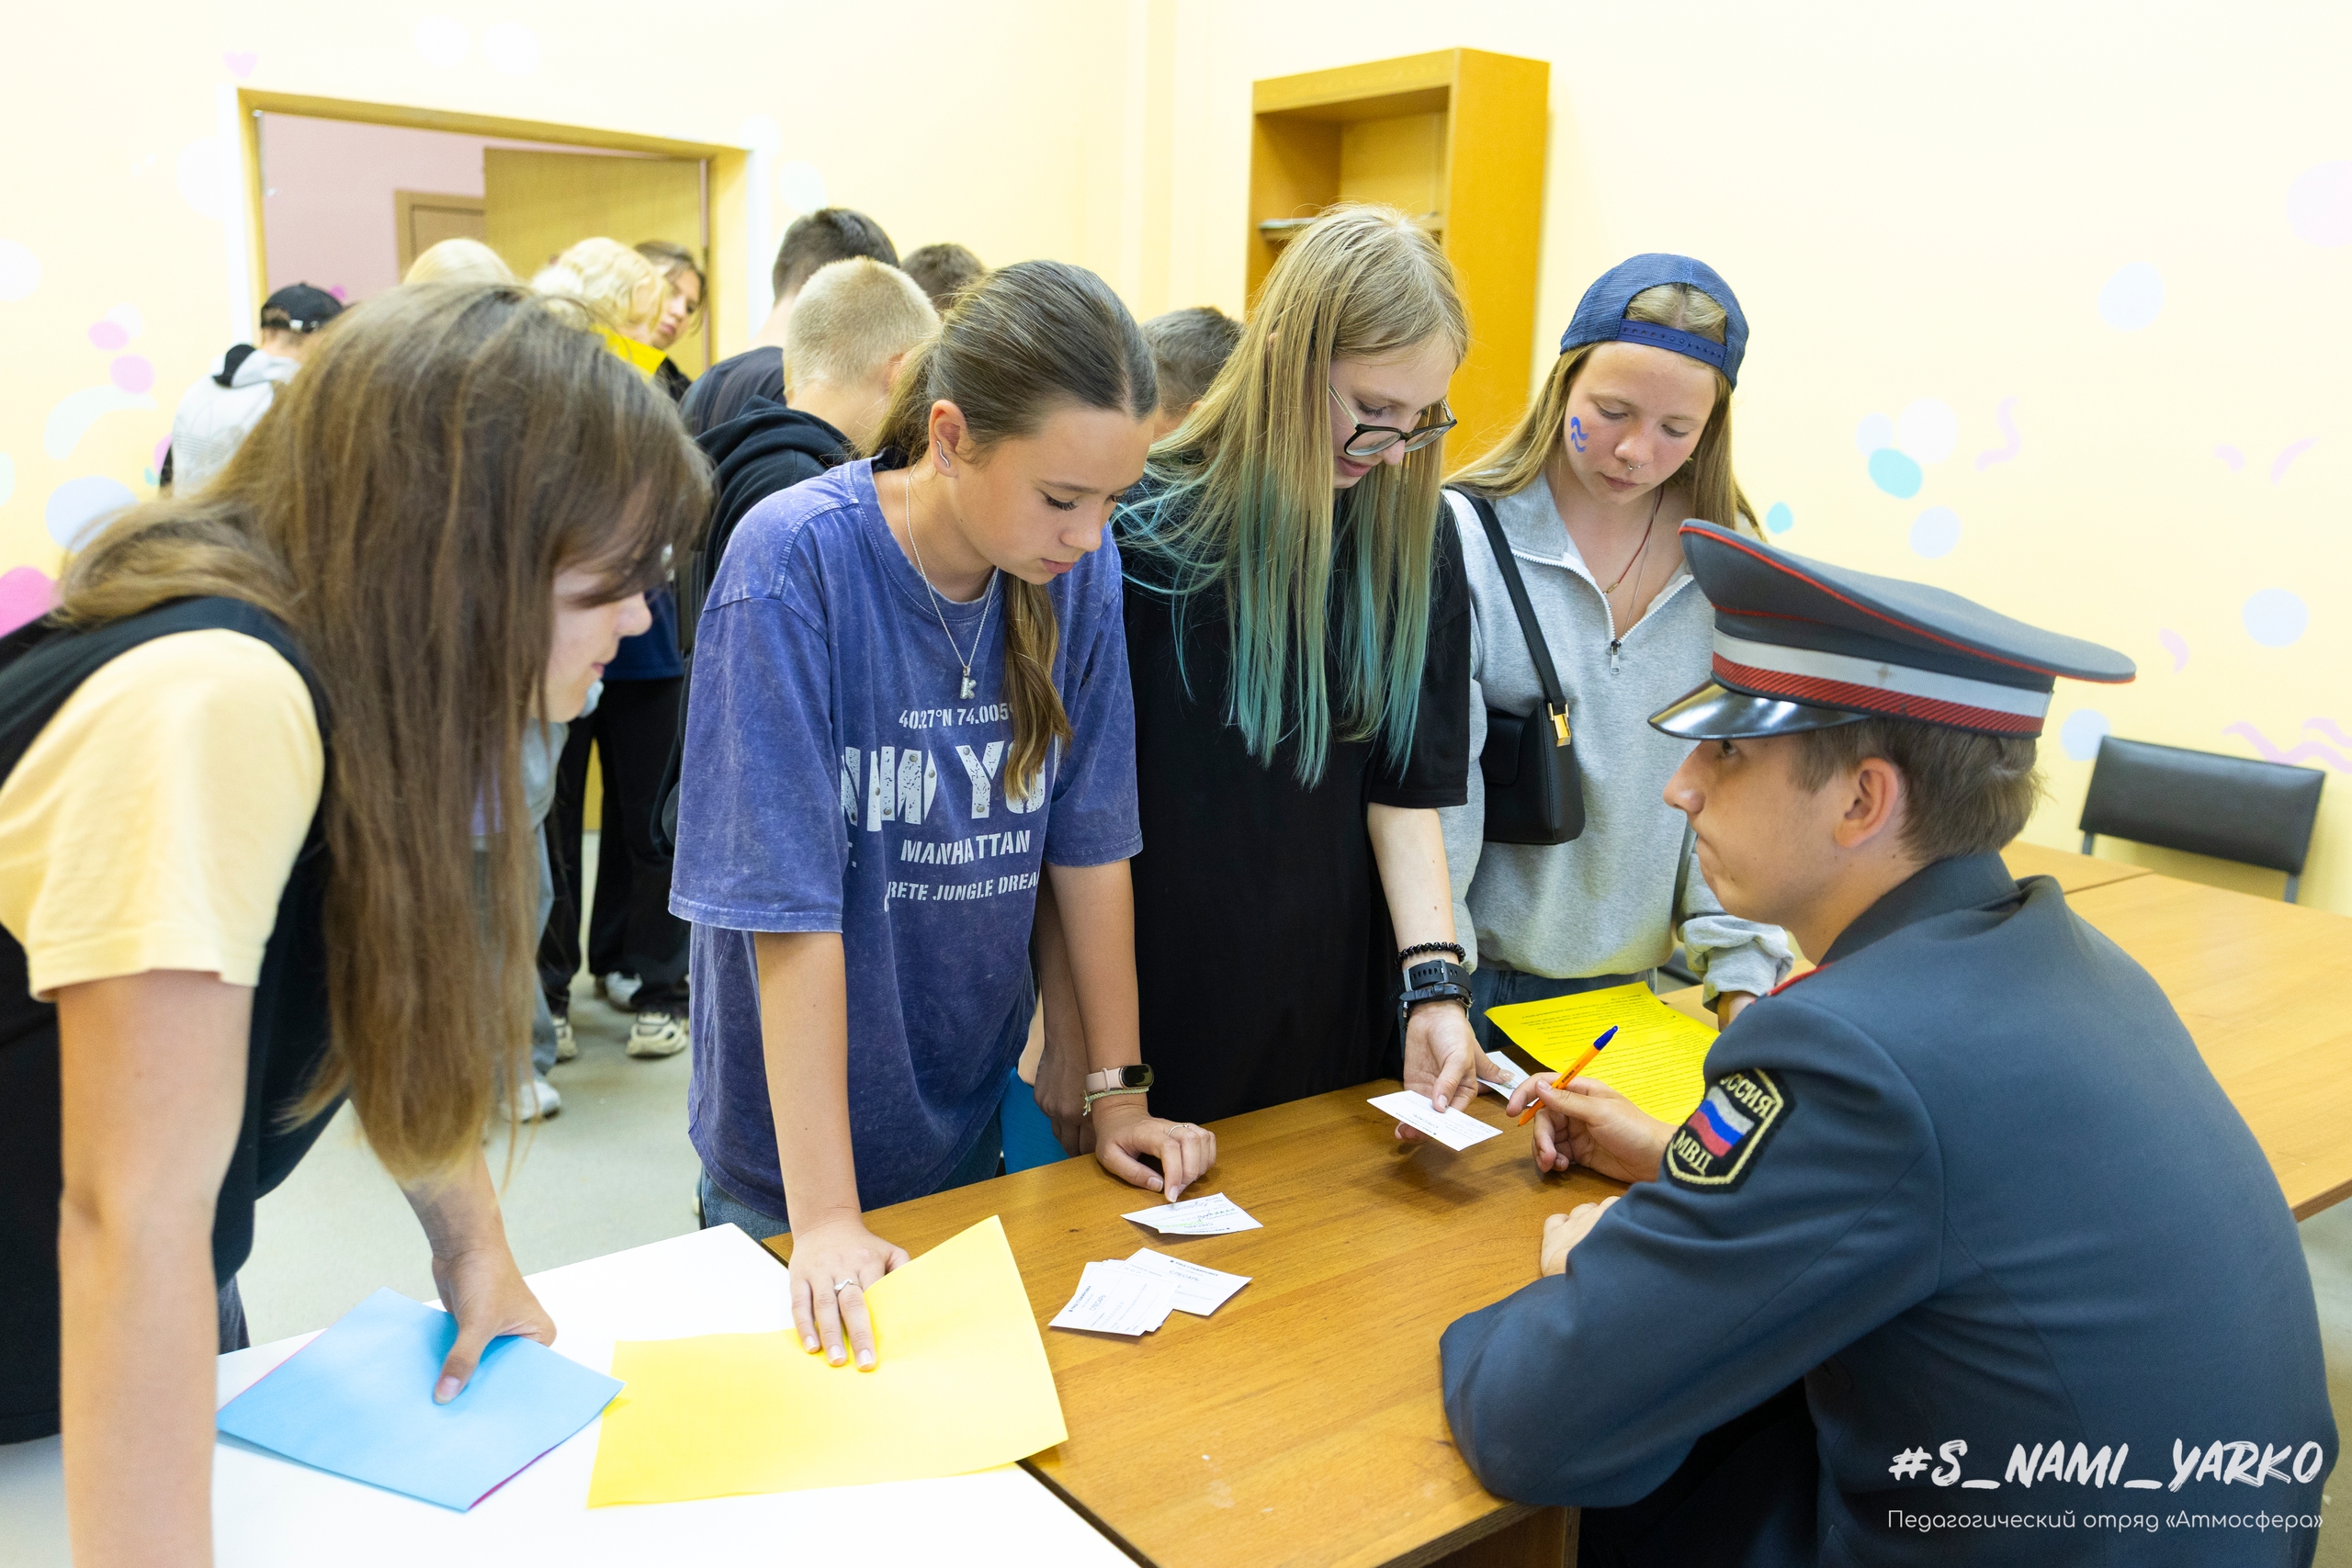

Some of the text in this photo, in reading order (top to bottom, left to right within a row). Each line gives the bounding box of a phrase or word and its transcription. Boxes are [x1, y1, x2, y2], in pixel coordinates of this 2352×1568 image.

[900, 829, 1031, 865] MANHATTAN
[933, 879, 994, 901] JUNGLE
[998, 871, 1040, 895] DREA
[1672, 1130, 1714, 1176] МВД
